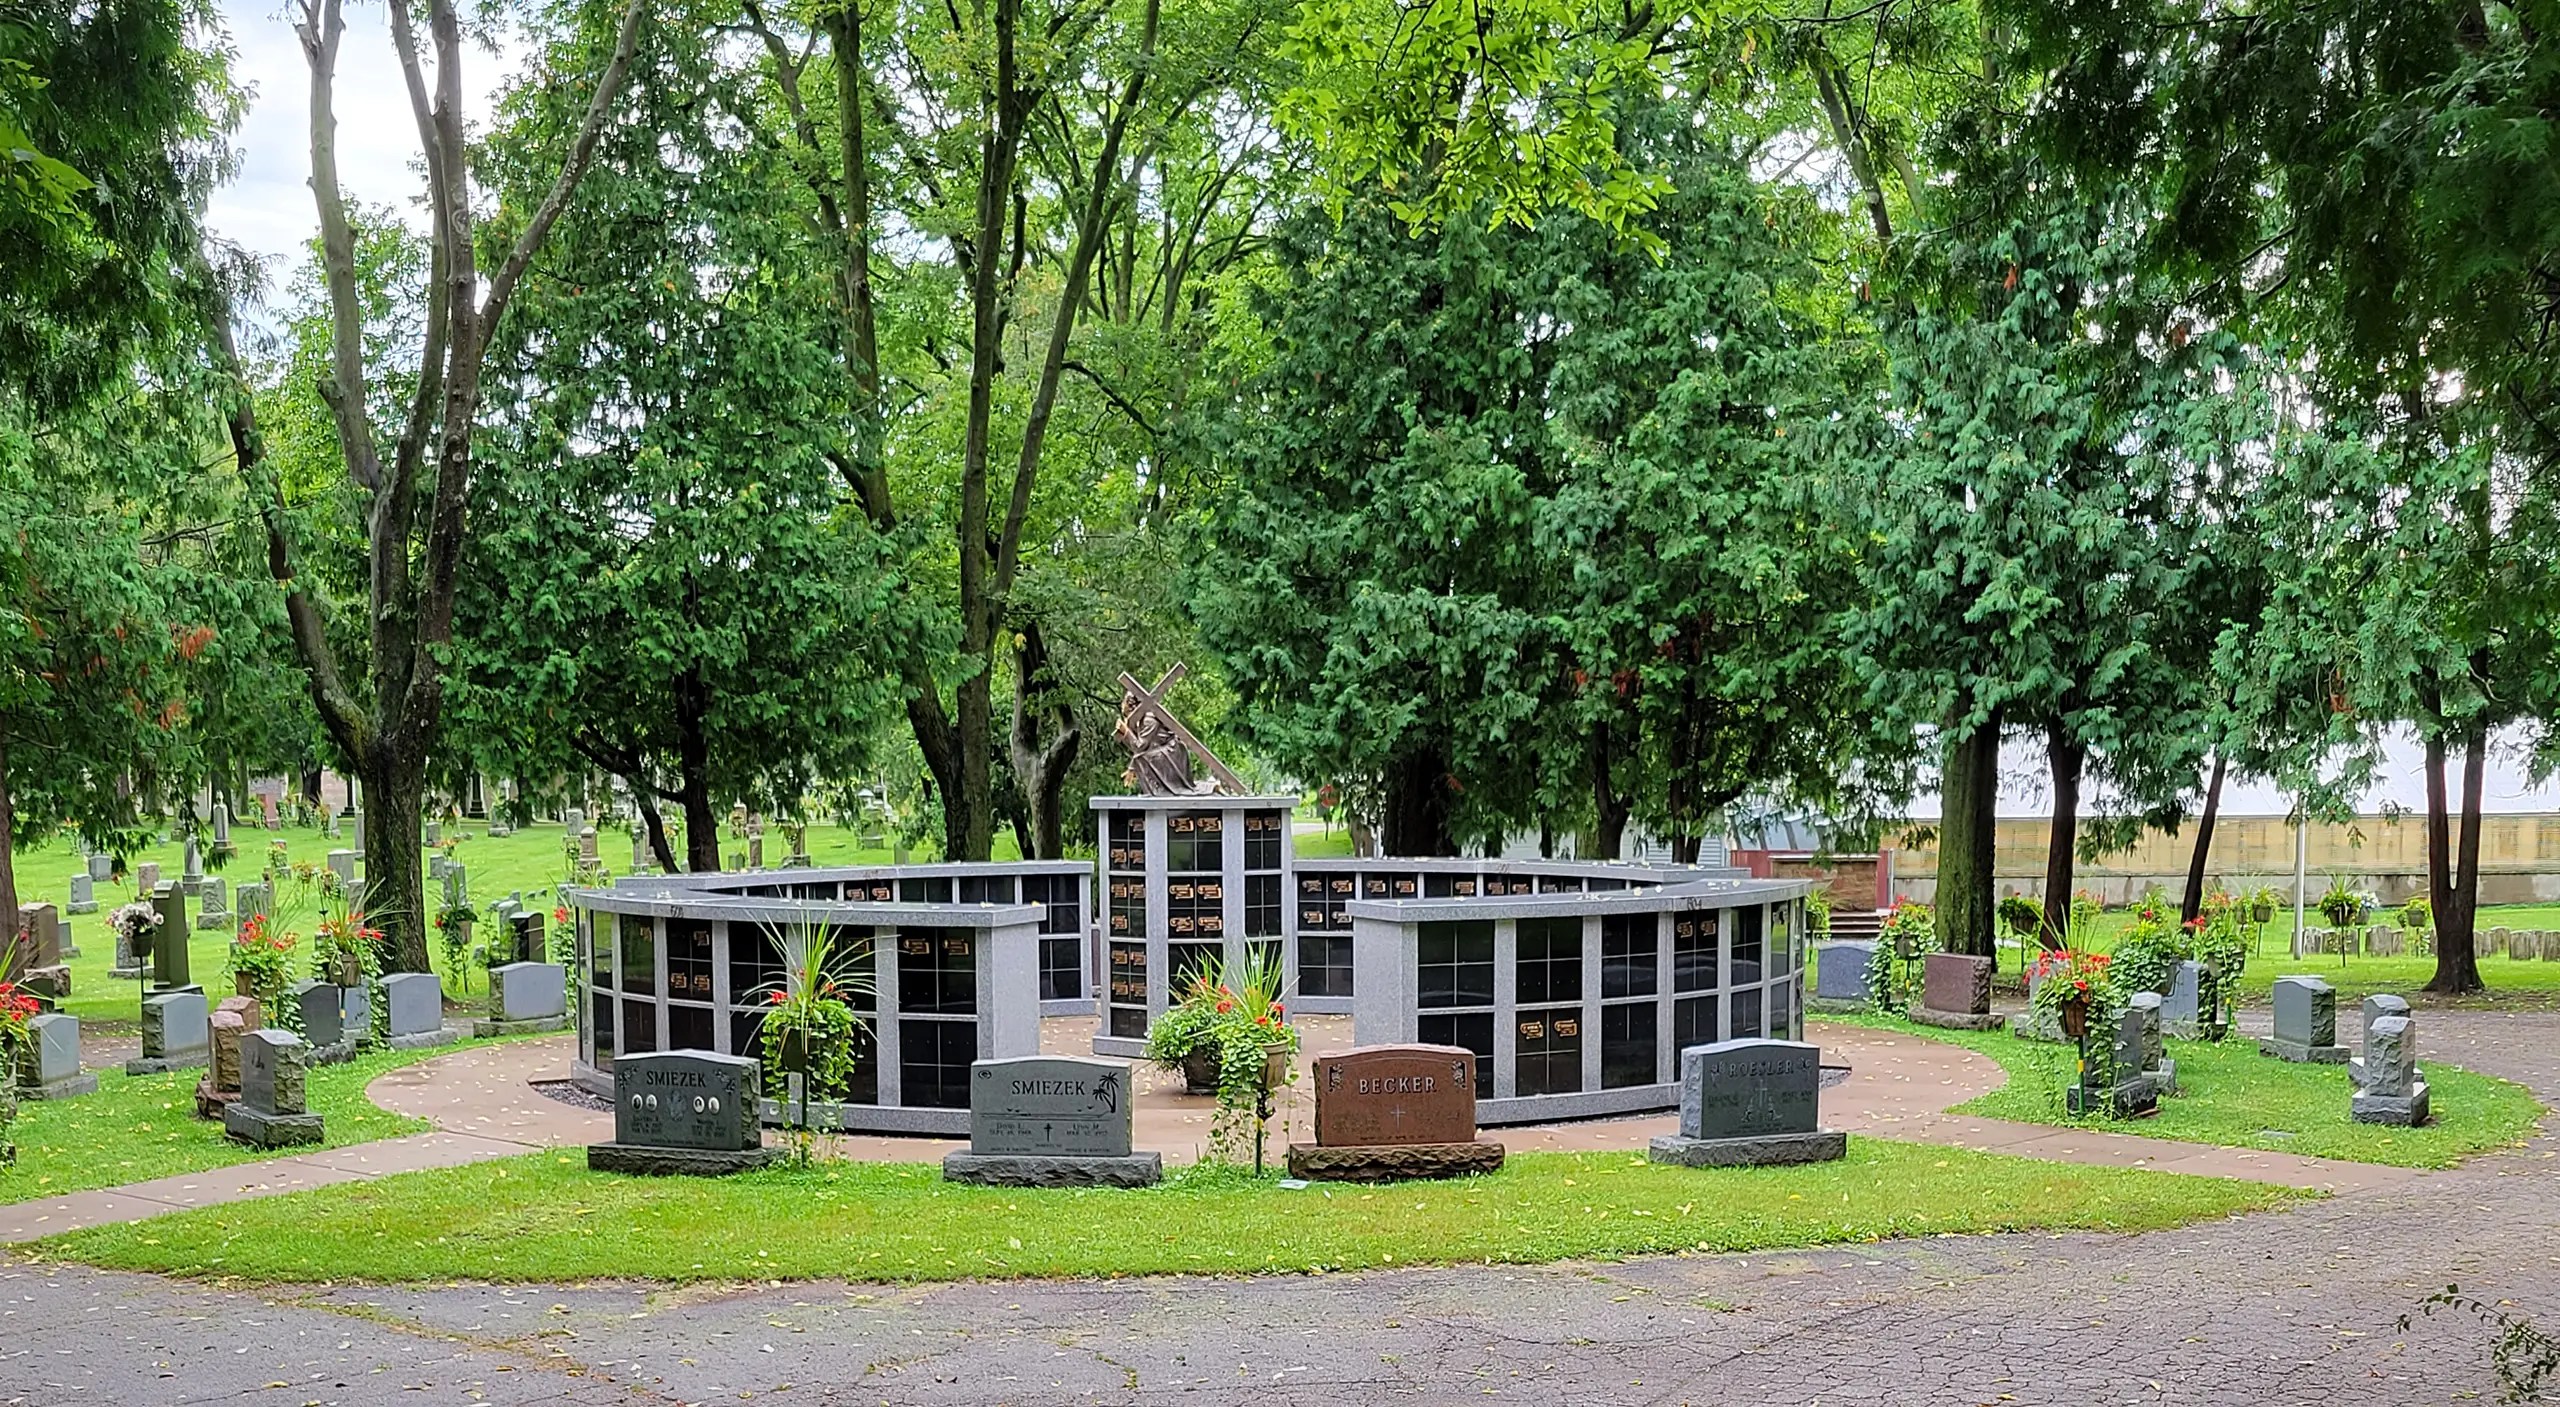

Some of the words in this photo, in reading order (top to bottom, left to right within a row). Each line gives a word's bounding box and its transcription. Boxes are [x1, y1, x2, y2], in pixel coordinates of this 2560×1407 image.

[646, 1070, 706, 1088] SMIEZEK
[1011, 1079, 1085, 1096] SMIEZEK
[1358, 1076, 1437, 1095] BECKER
